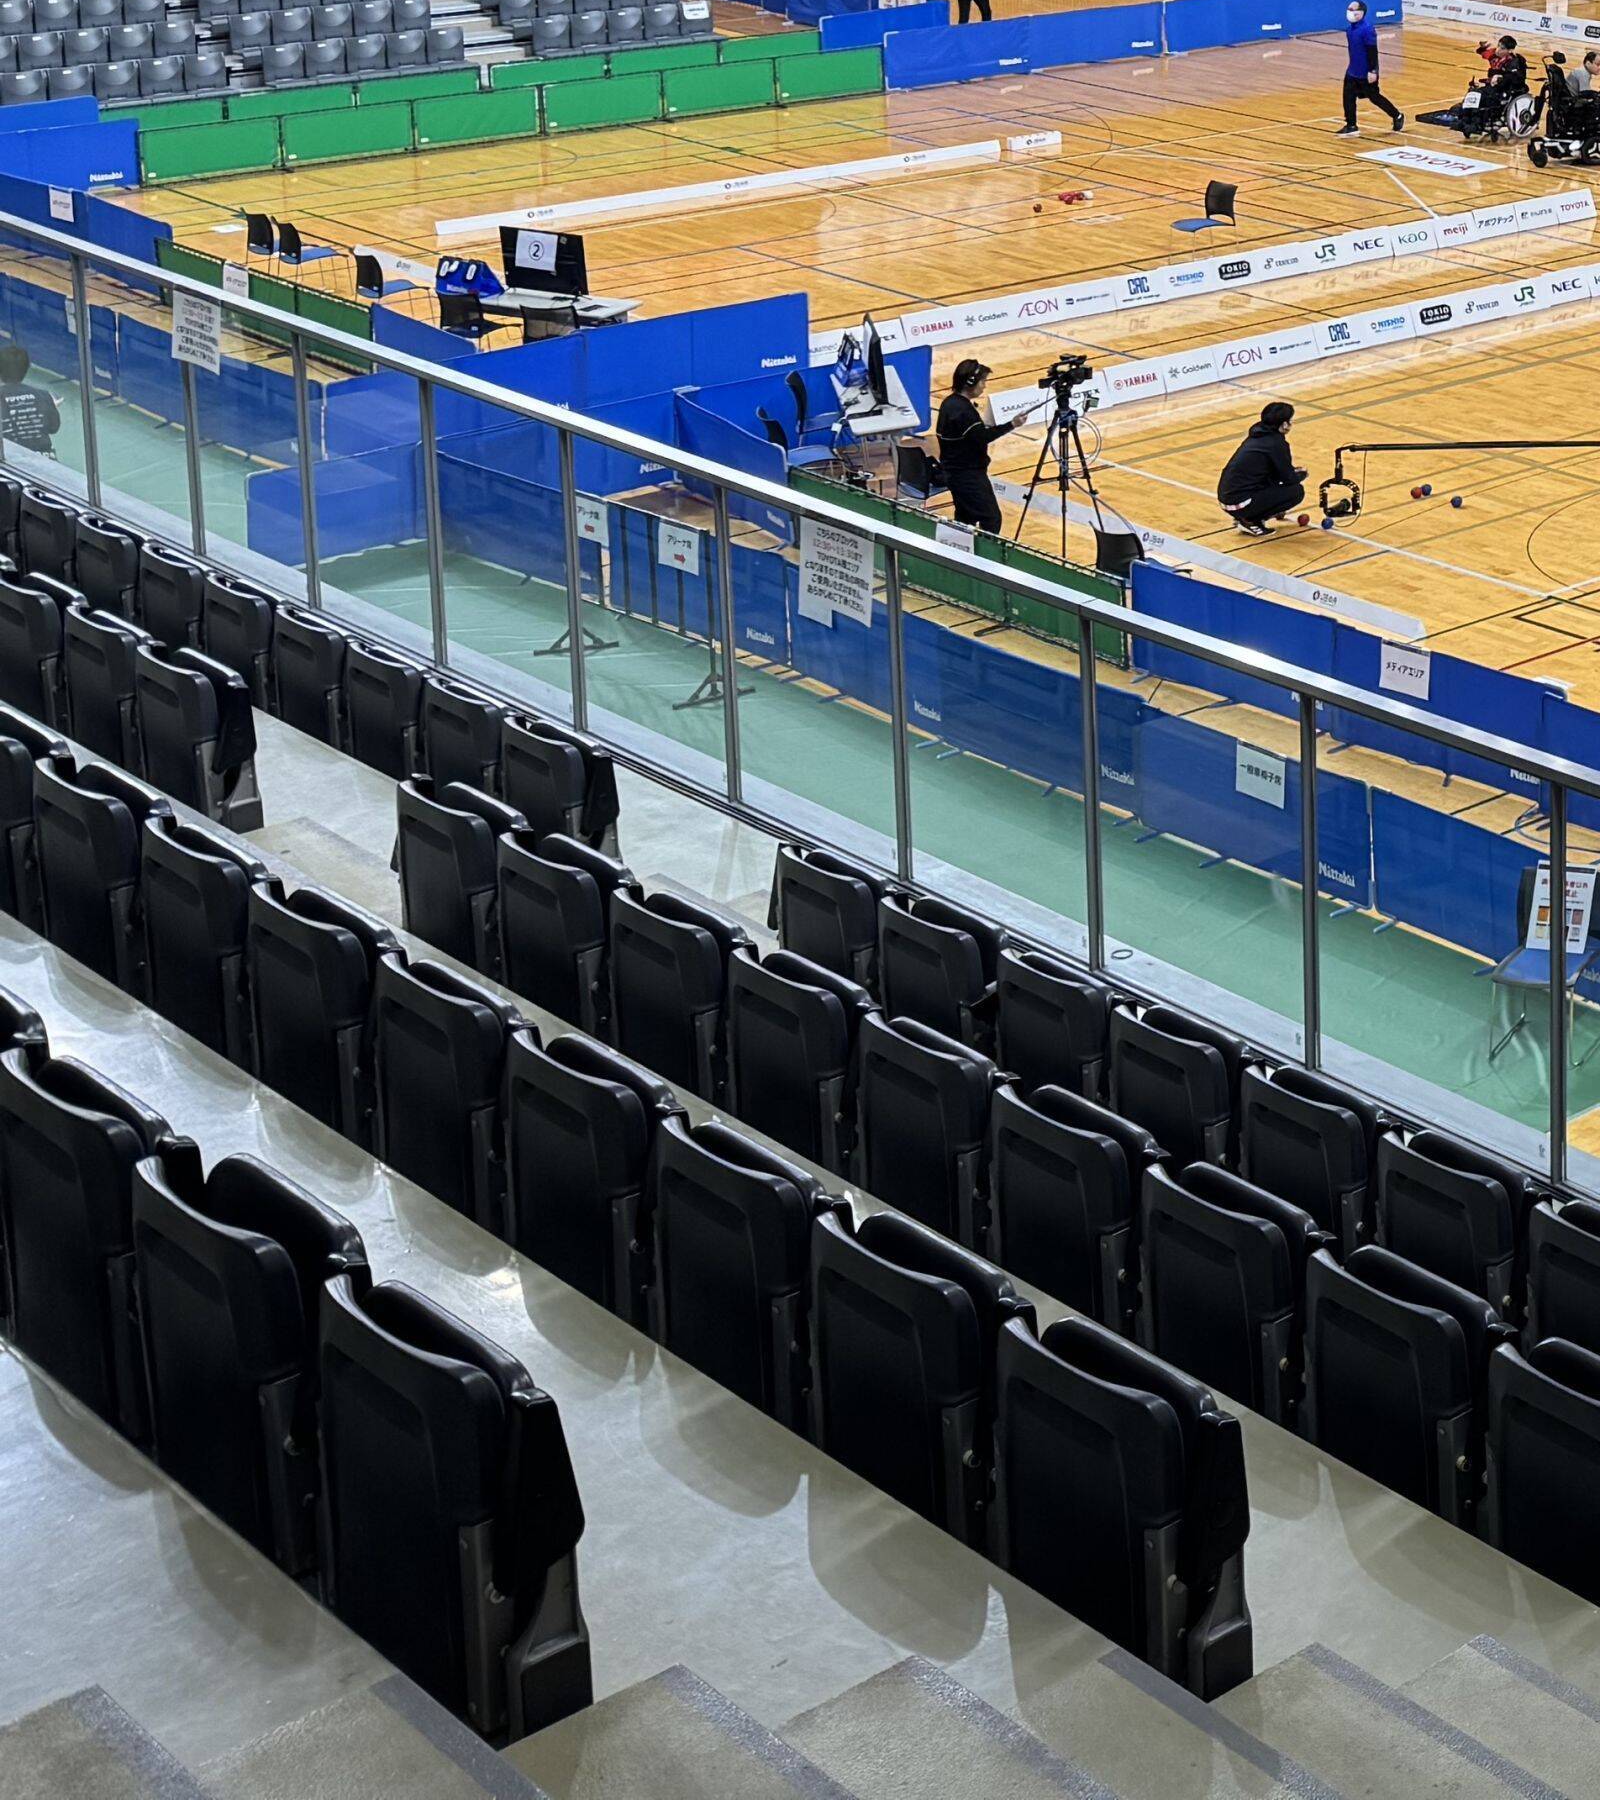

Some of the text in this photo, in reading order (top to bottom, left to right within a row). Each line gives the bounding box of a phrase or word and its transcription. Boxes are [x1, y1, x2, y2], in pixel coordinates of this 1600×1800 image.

[919, 319, 955, 336] YAMAHA
[977, 310, 1009, 324] Goldwin
[1314, 243, 1337, 260] JR
[1352, 237, 1385, 252] NEC
[1443, 222, 1469, 237] meiji
[1560, 200, 1591, 213] TOYOTA
[1123, 372, 1158, 388] YAMAHA
[1182, 360, 1213, 375] Goldwin
[1513, 285, 1536, 302] JR
[1551, 277, 1583, 294] NEC
[746, 626, 775, 646] Nittaku
[1385, 660, 1425, 681] メディアエリア
[1100, 763, 1135, 786] Nittaku
[1317, 860, 1356, 888] Nittaku
